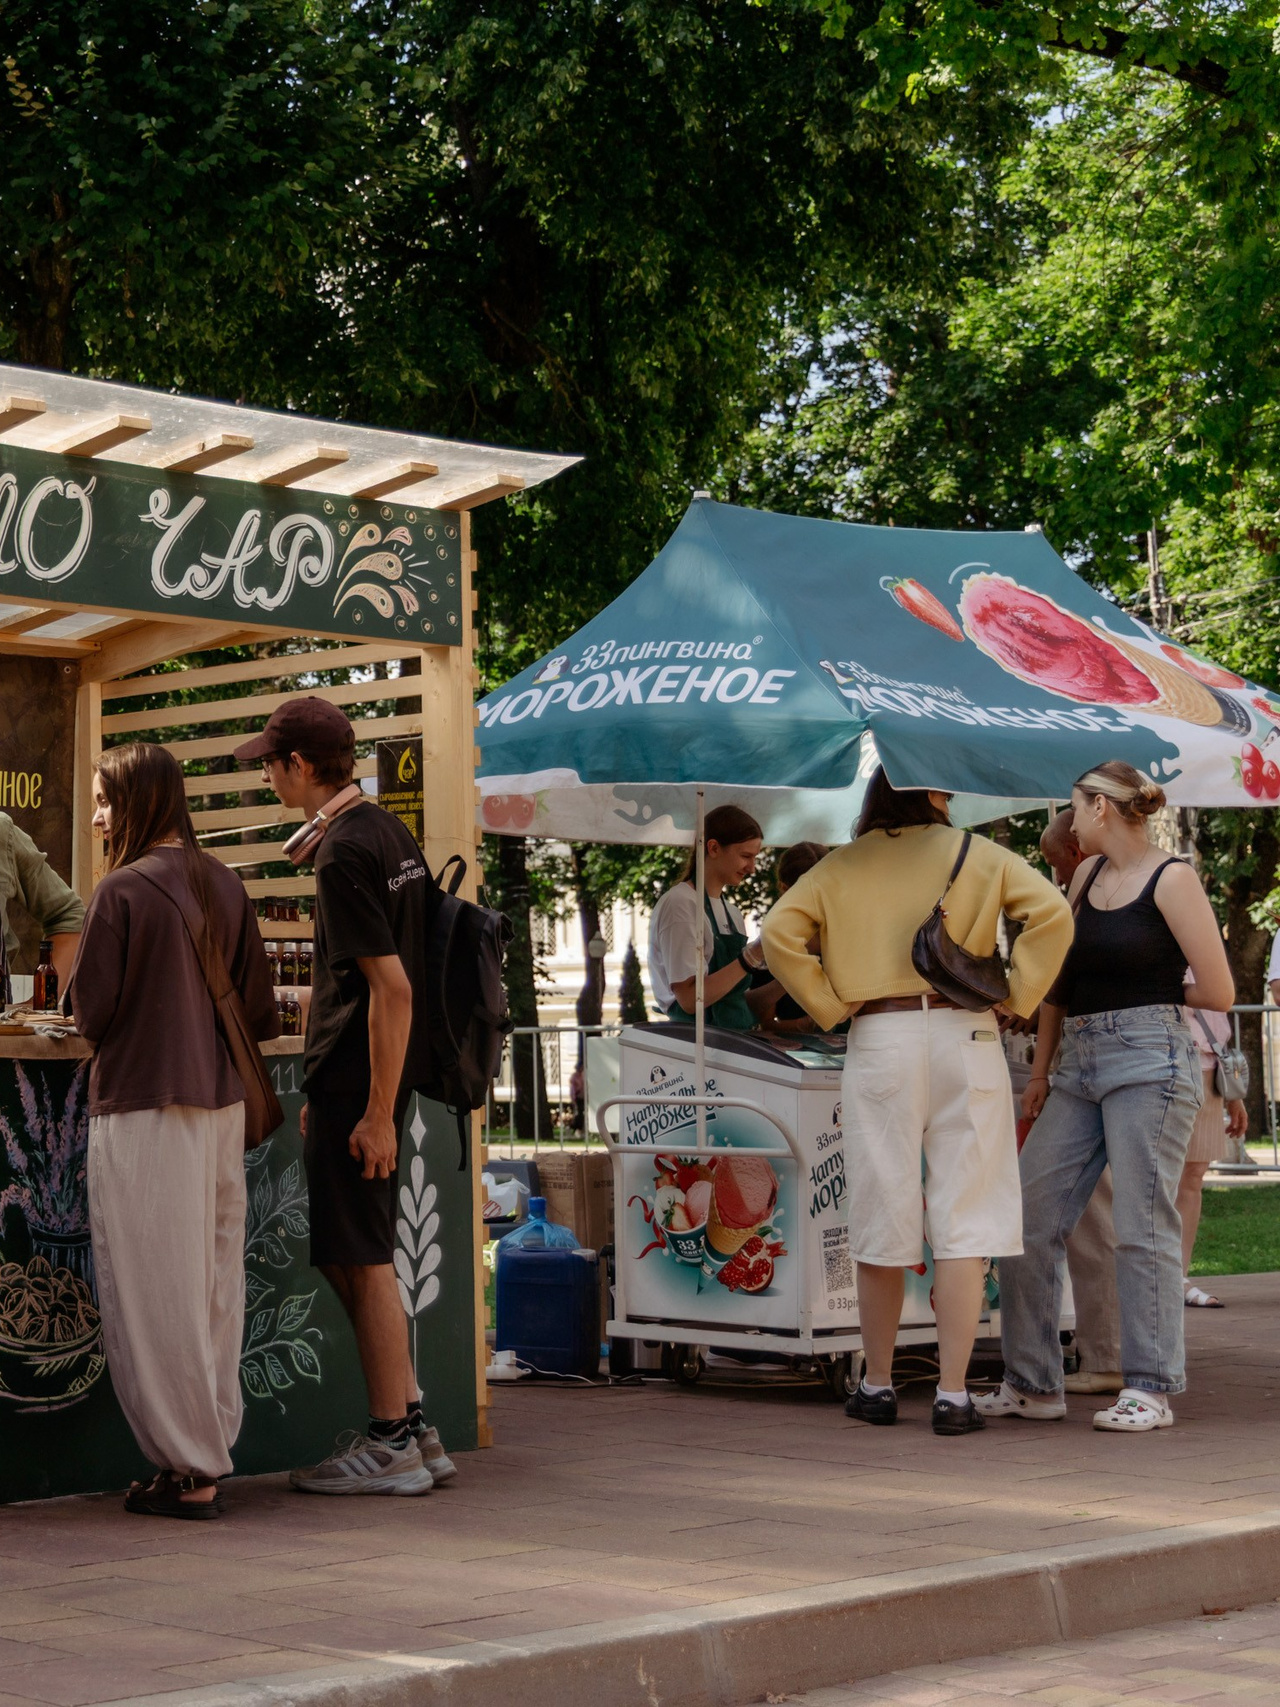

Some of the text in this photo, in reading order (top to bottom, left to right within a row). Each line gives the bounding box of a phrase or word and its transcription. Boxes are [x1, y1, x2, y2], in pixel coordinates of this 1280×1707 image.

[140, 487, 335, 611] ЧАР
[477, 665, 797, 727] МОРОЖЕНОЕ
[837, 683, 1132, 732] МОРОЖЕНОЕ
